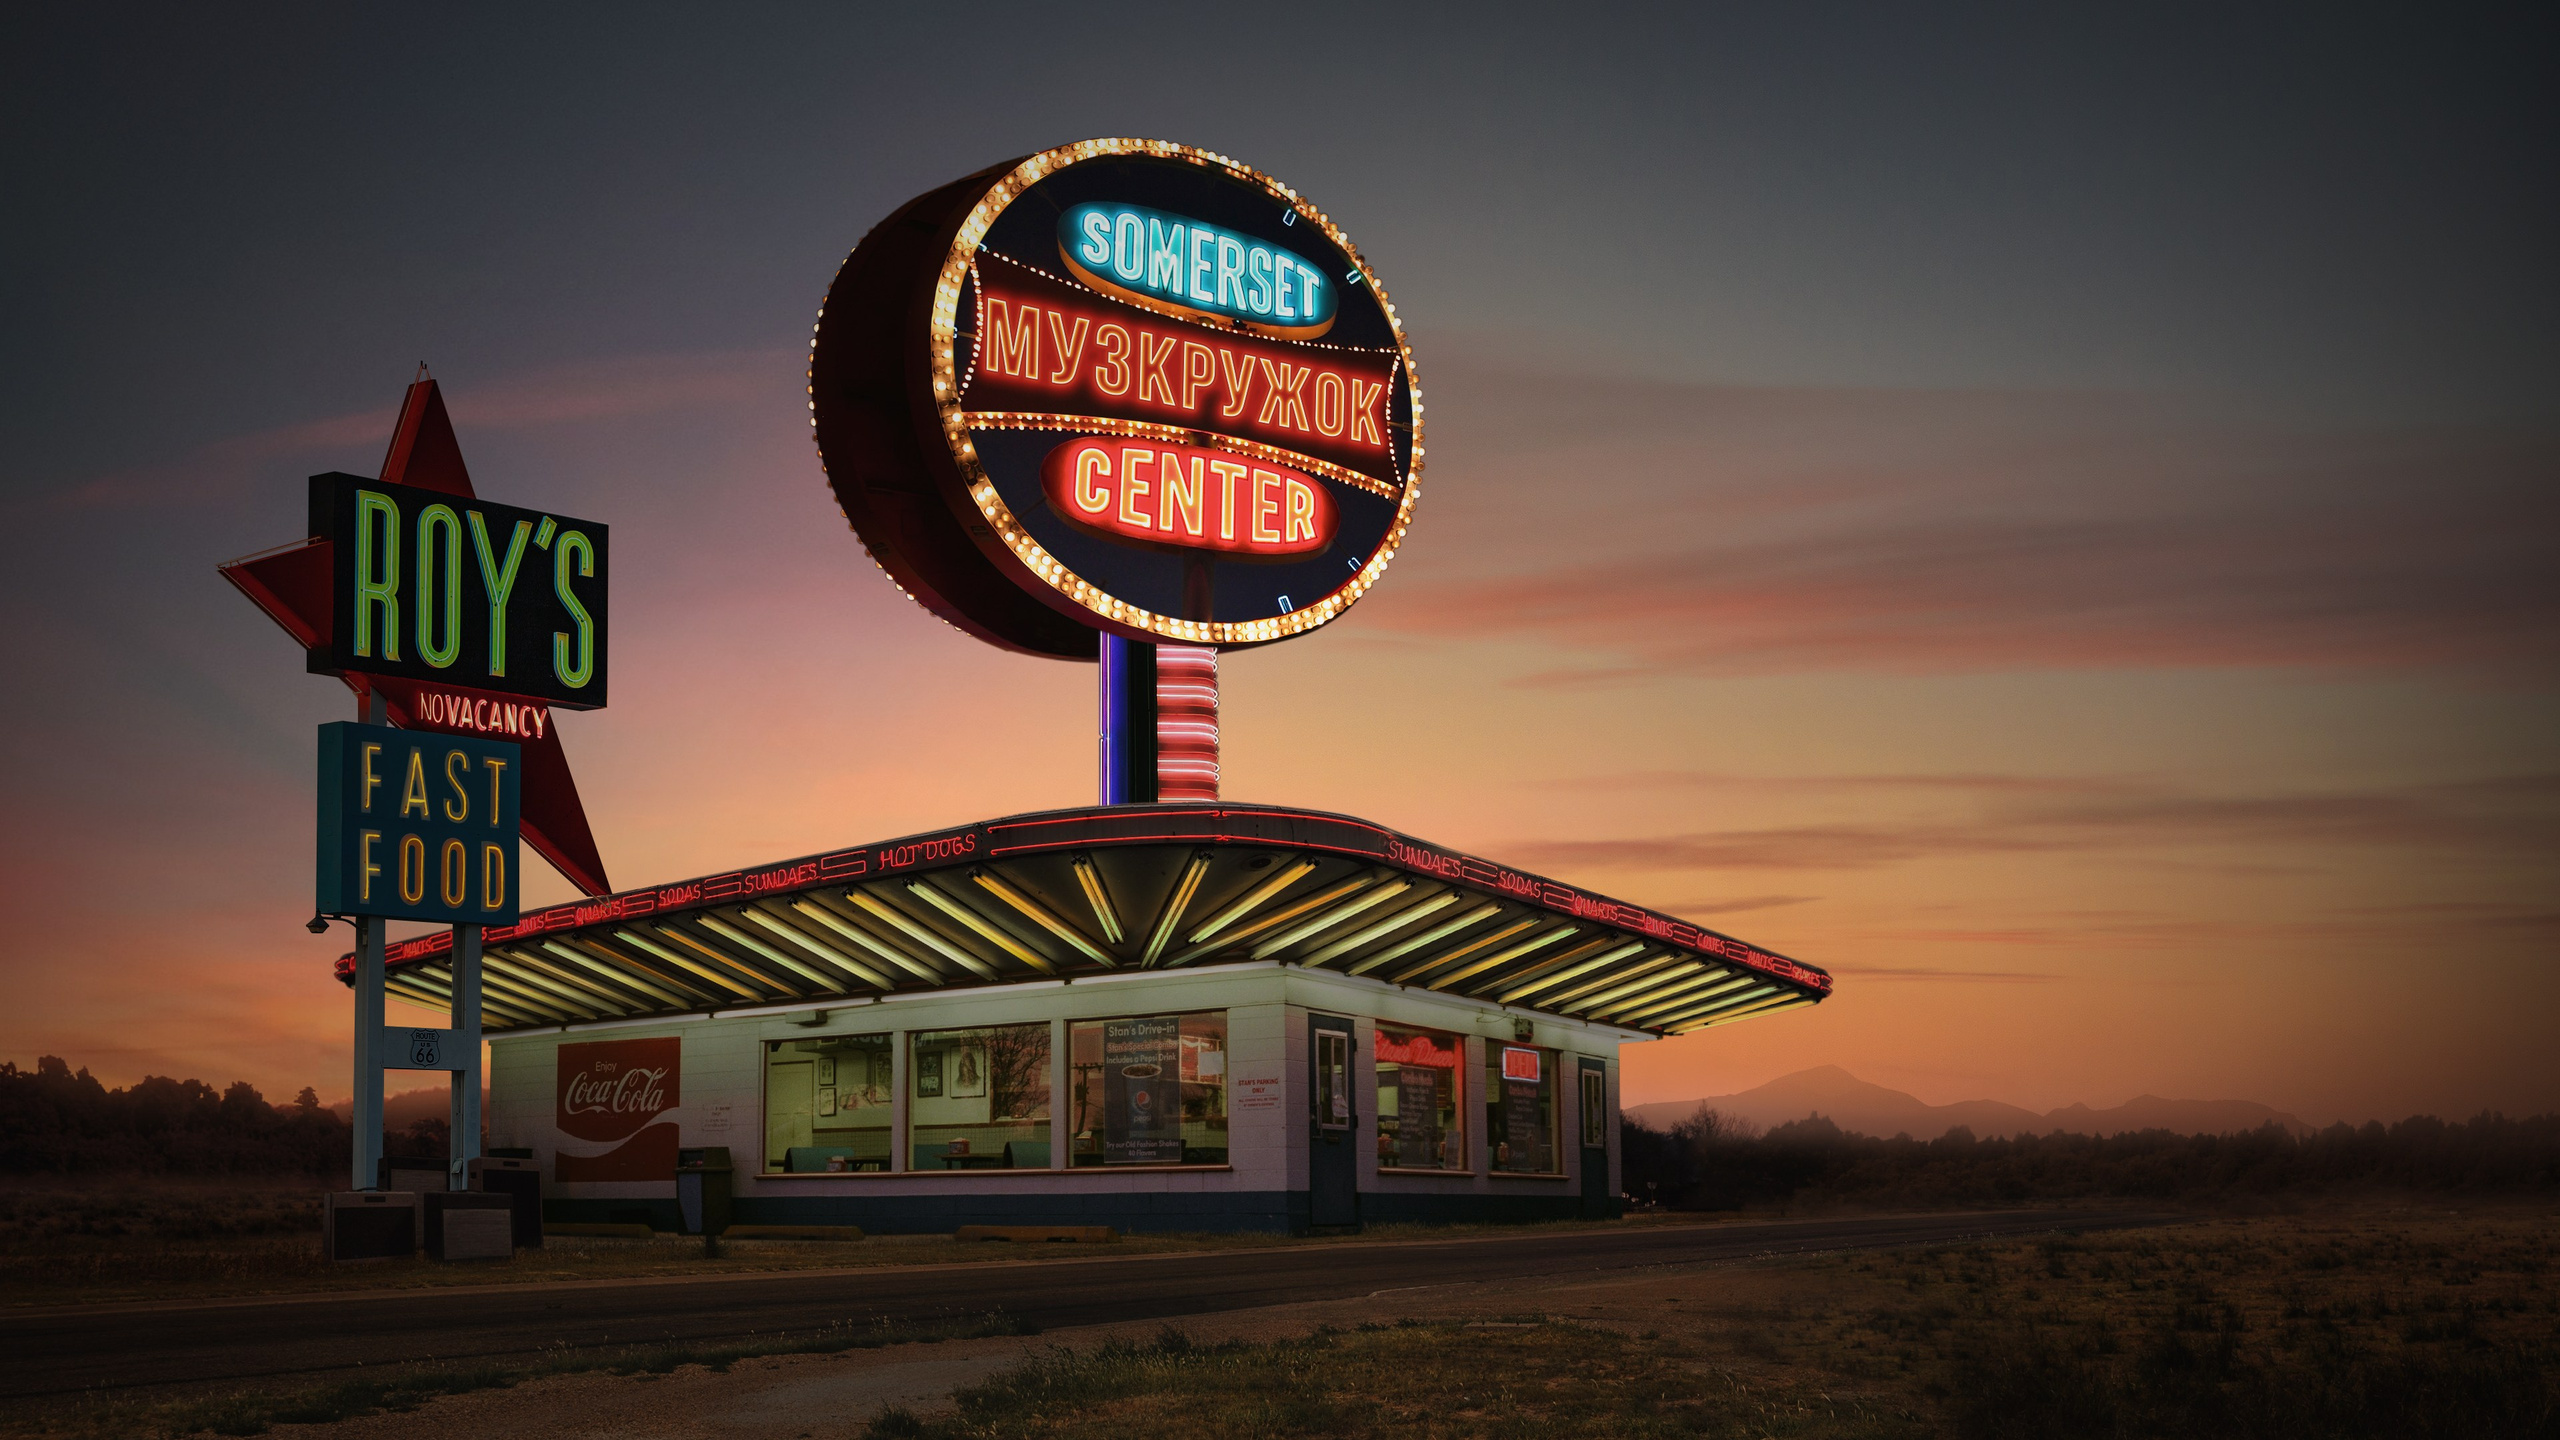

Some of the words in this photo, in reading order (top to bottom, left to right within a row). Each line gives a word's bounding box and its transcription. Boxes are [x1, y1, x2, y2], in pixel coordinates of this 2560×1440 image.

[1081, 211, 1322, 321] SOMERSET
[984, 297, 1384, 447] МУЗКРУЖОК
[1074, 447, 1318, 544] CENTER
[354, 489, 594, 689] ROY'S
[420, 692, 444, 723] NO
[445, 694, 548, 739] VACANCY
[361, 741, 508, 828] FAST
[878, 845, 918, 870] HOT
[923, 833, 976, 860] DOGS
[1388, 841, 1461, 878] SUNDAES
[359, 829, 507, 912] FOOD
[743, 861, 818, 895] SUNDAES
[1497, 870, 1542, 899] SODAS
[658, 883, 702, 908] SODAS
[1574, 896, 1618, 922] QUARTS
[574, 898, 622, 928] QUARTS
[415, 1032, 436, 1040] ROUTE
[1108, 1025, 1136, 1038] Stan's
[1138, 1022, 1176, 1036] Drive-in
[416, 1047, 435, 1063] 66
[595, 1061, 618, 1073] Enjoy
[1106, 1055, 1133, 1065] Includes
[1140, 1054, 1158, 1064] Pepsi
[1158, 1052, 1176, 1062] Drink
[1505, 1049, 1538, 1079] OPEN
[564, 1067, 670, 1115] Coca-Cola
[1133, 1114, 1152, 1124] pepsi
